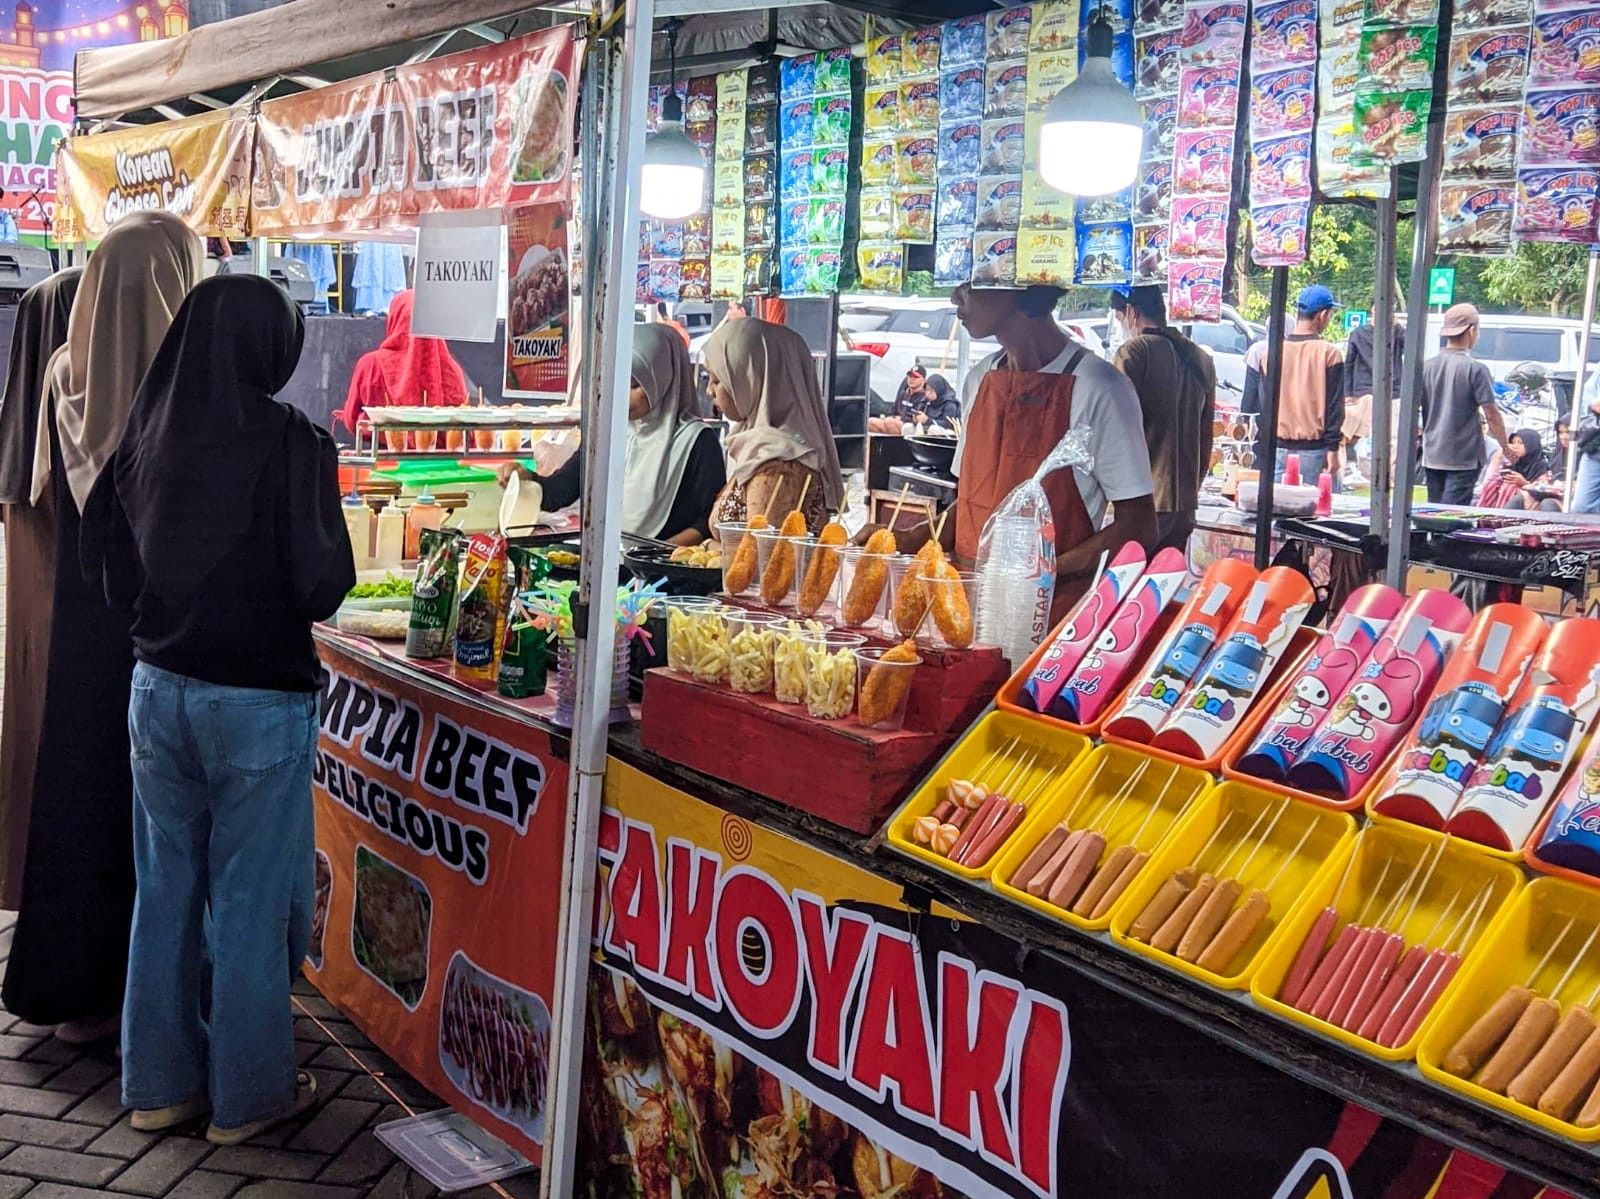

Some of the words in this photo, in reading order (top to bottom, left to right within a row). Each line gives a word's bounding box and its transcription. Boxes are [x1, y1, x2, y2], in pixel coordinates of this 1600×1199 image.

[115, 149, 174, 187] Korean
[415, 95, 496, 190] BEEF
[424, 260, 494, 282] TAKOYAKI
[513, 338, 562, 359] TAKOYAKI
[424, 717, 541, 828] BEEF
[313, 751, 486, 880] DELICIOUS
